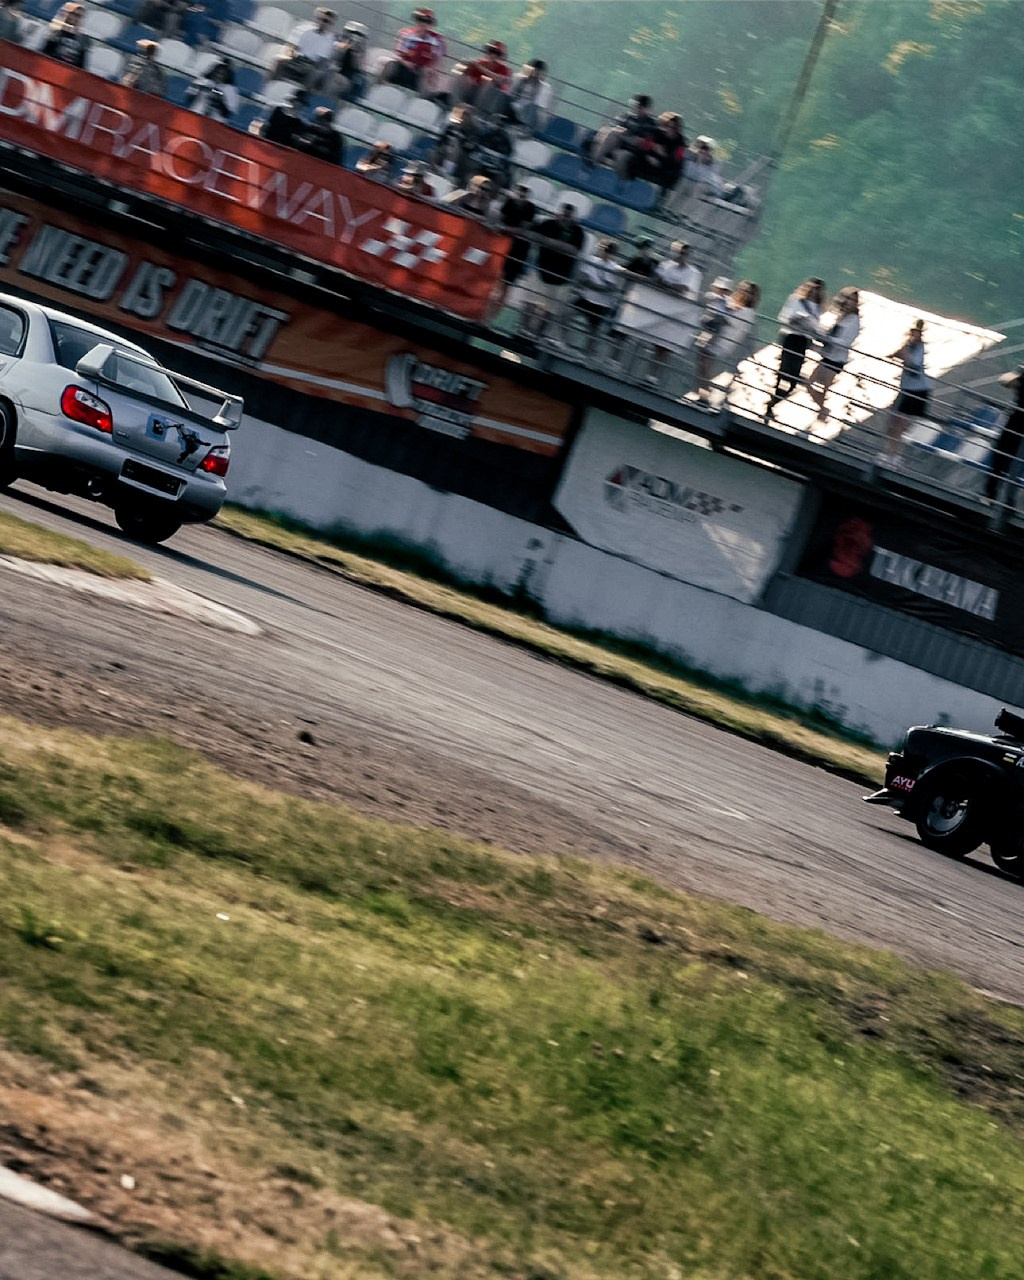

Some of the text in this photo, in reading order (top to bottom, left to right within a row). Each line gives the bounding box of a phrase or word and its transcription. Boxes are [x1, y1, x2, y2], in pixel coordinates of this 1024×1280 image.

[18, 224, 127, 301] NEED
[120, 260, 175, 319] IS
[167, 279, 290, 361] DRIFT
